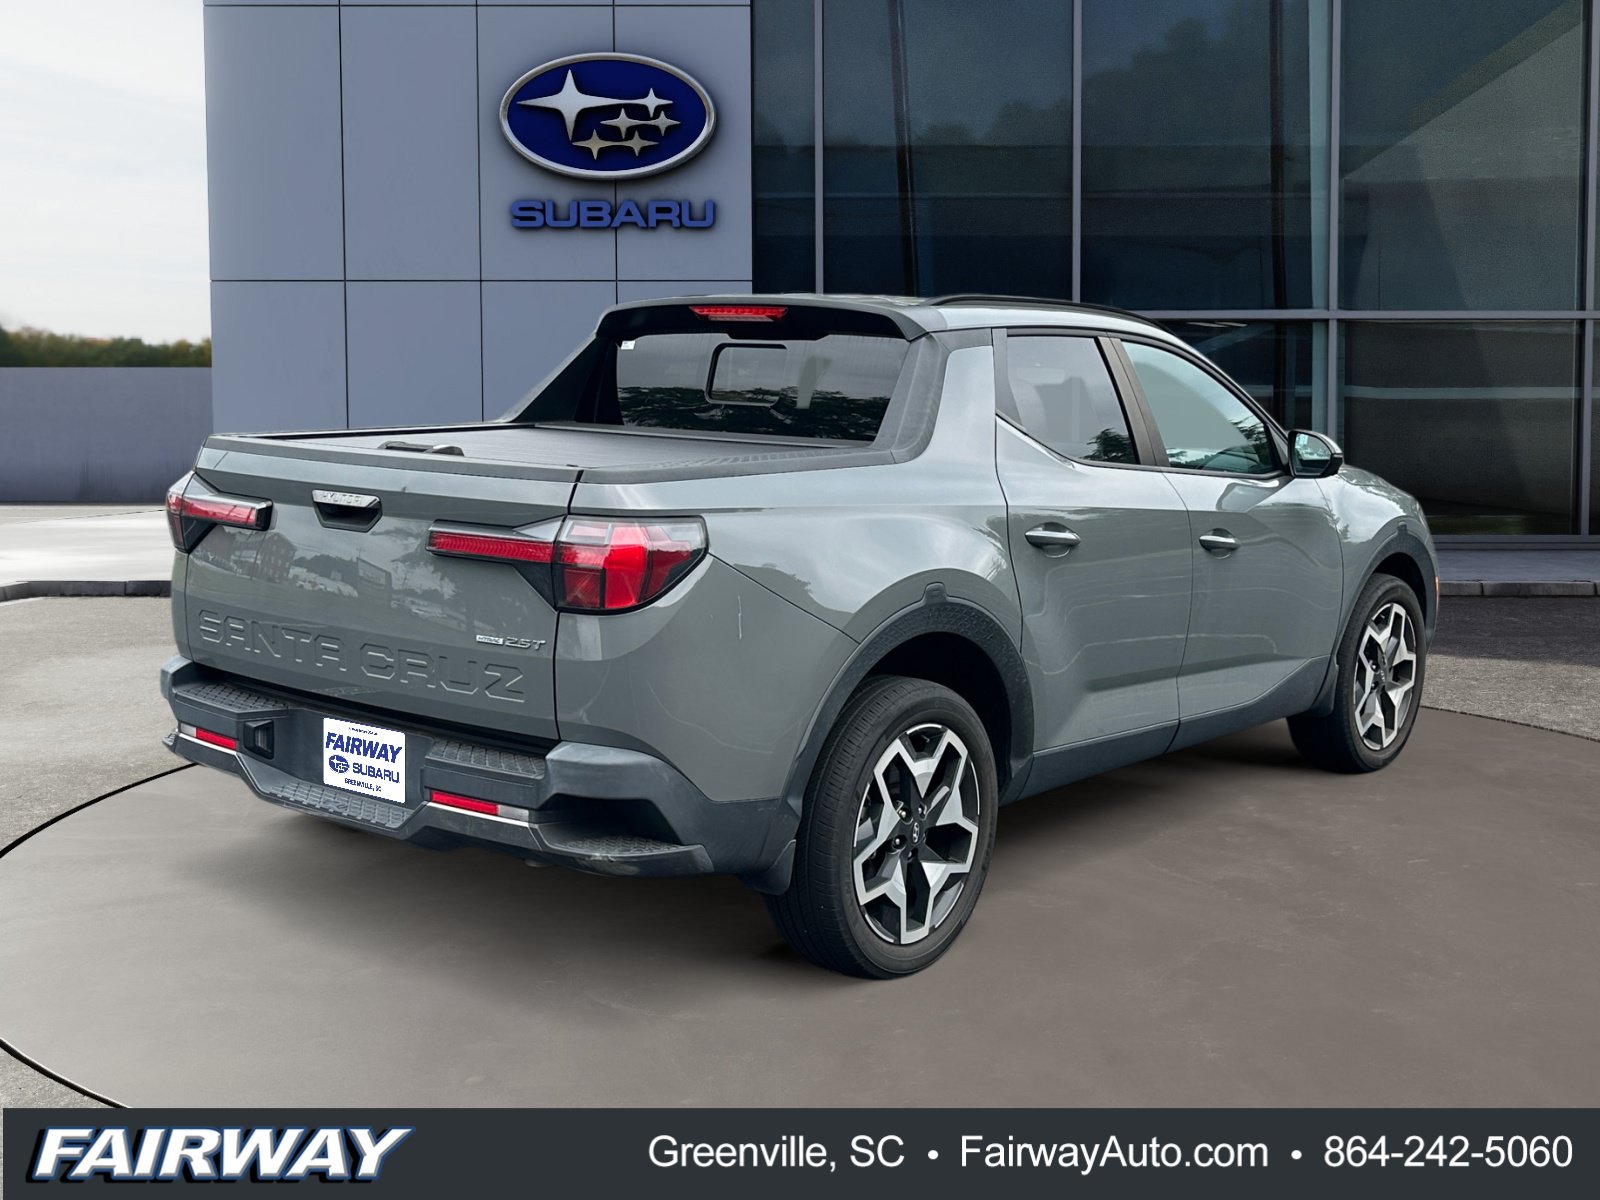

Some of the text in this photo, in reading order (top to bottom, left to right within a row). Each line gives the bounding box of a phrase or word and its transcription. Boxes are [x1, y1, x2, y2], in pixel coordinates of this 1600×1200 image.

[511, 200, 715, 228] SUBARU
[199, 609, 525, 703] SANTA CRUZ
[325, 731, 403, 764] FAIRWAY
[352, 762, 400, 784] SUBARU
